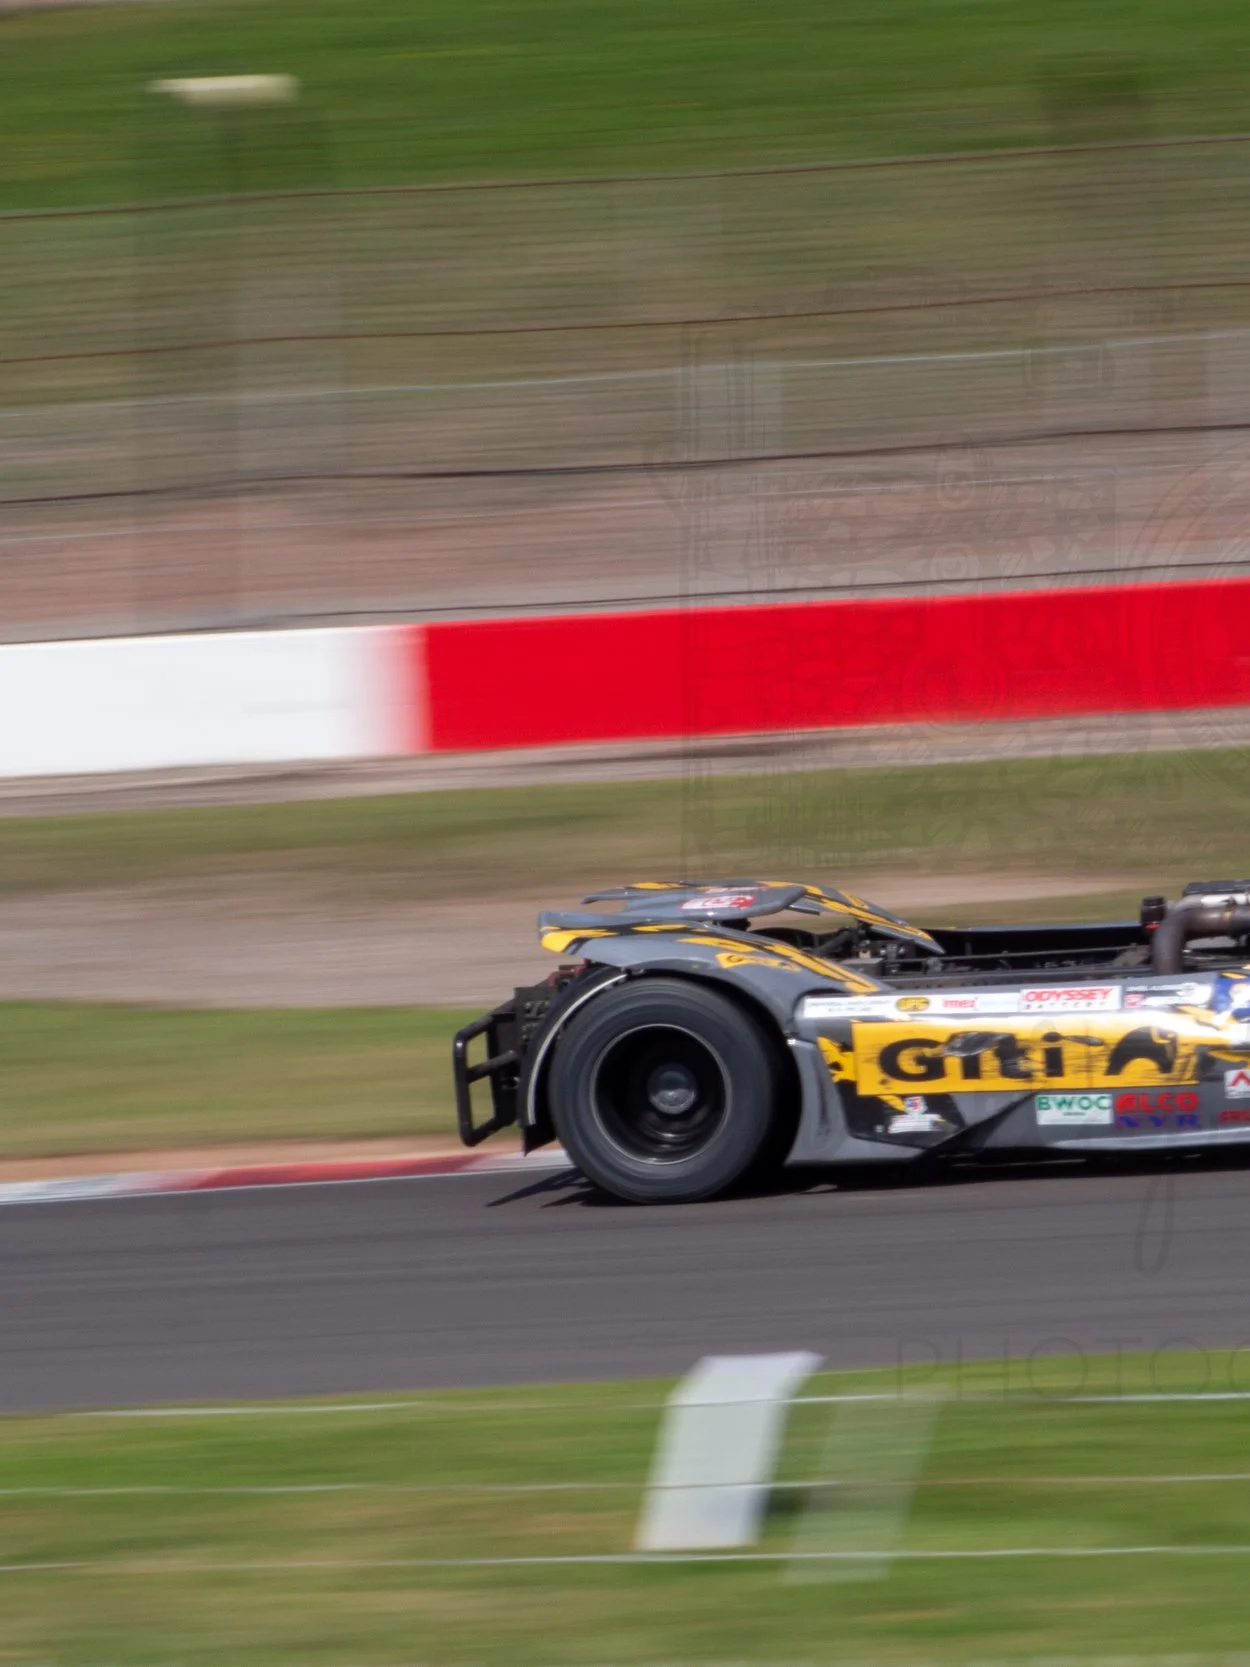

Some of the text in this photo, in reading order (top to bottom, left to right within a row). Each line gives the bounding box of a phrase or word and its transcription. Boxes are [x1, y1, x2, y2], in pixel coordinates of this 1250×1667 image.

[1024, 988, 1111, 1002] ODYSSEY
[1037, 1096, 1112, 1110] BWOC
[1115, 1092, 1199, 1113] ALCO
